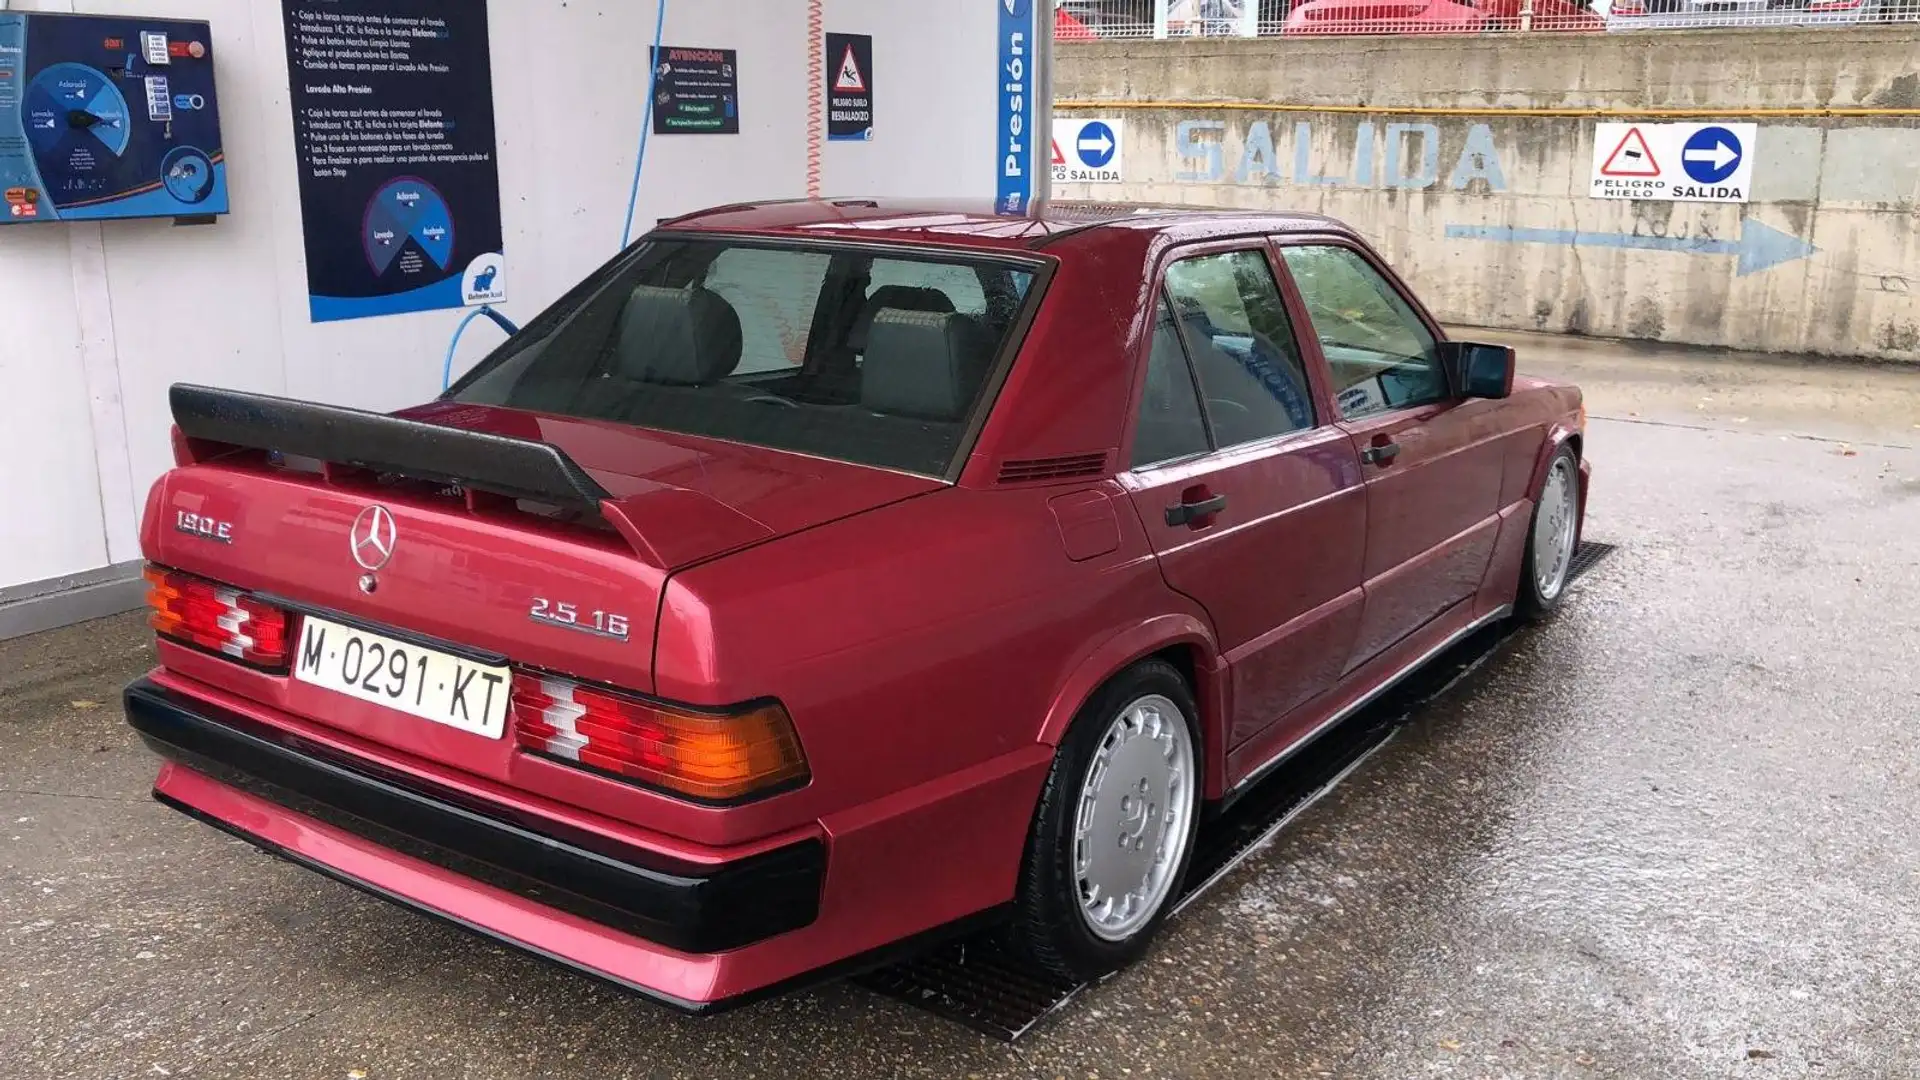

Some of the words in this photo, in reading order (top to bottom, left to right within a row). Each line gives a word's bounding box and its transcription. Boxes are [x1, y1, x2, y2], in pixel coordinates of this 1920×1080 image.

[306, 84, 331, 93] Lavado
[332, 84, 346, 93] Alta
[1006, 32, 1023, 177] Presión
[1175, 120, 1507, 190] SALIDA
[1070, 170, 1120, 180] SALIDA
[1594, 179, 1666, 188] PELIGRO
[1604, 189, 1654, 198] HIELO
[1672, 186, 1742, 199] SALIDA
[218, 521, 232, 538] E
[530, 597, 576, 623] 2.5
[592, 610, 629, 635] 16
